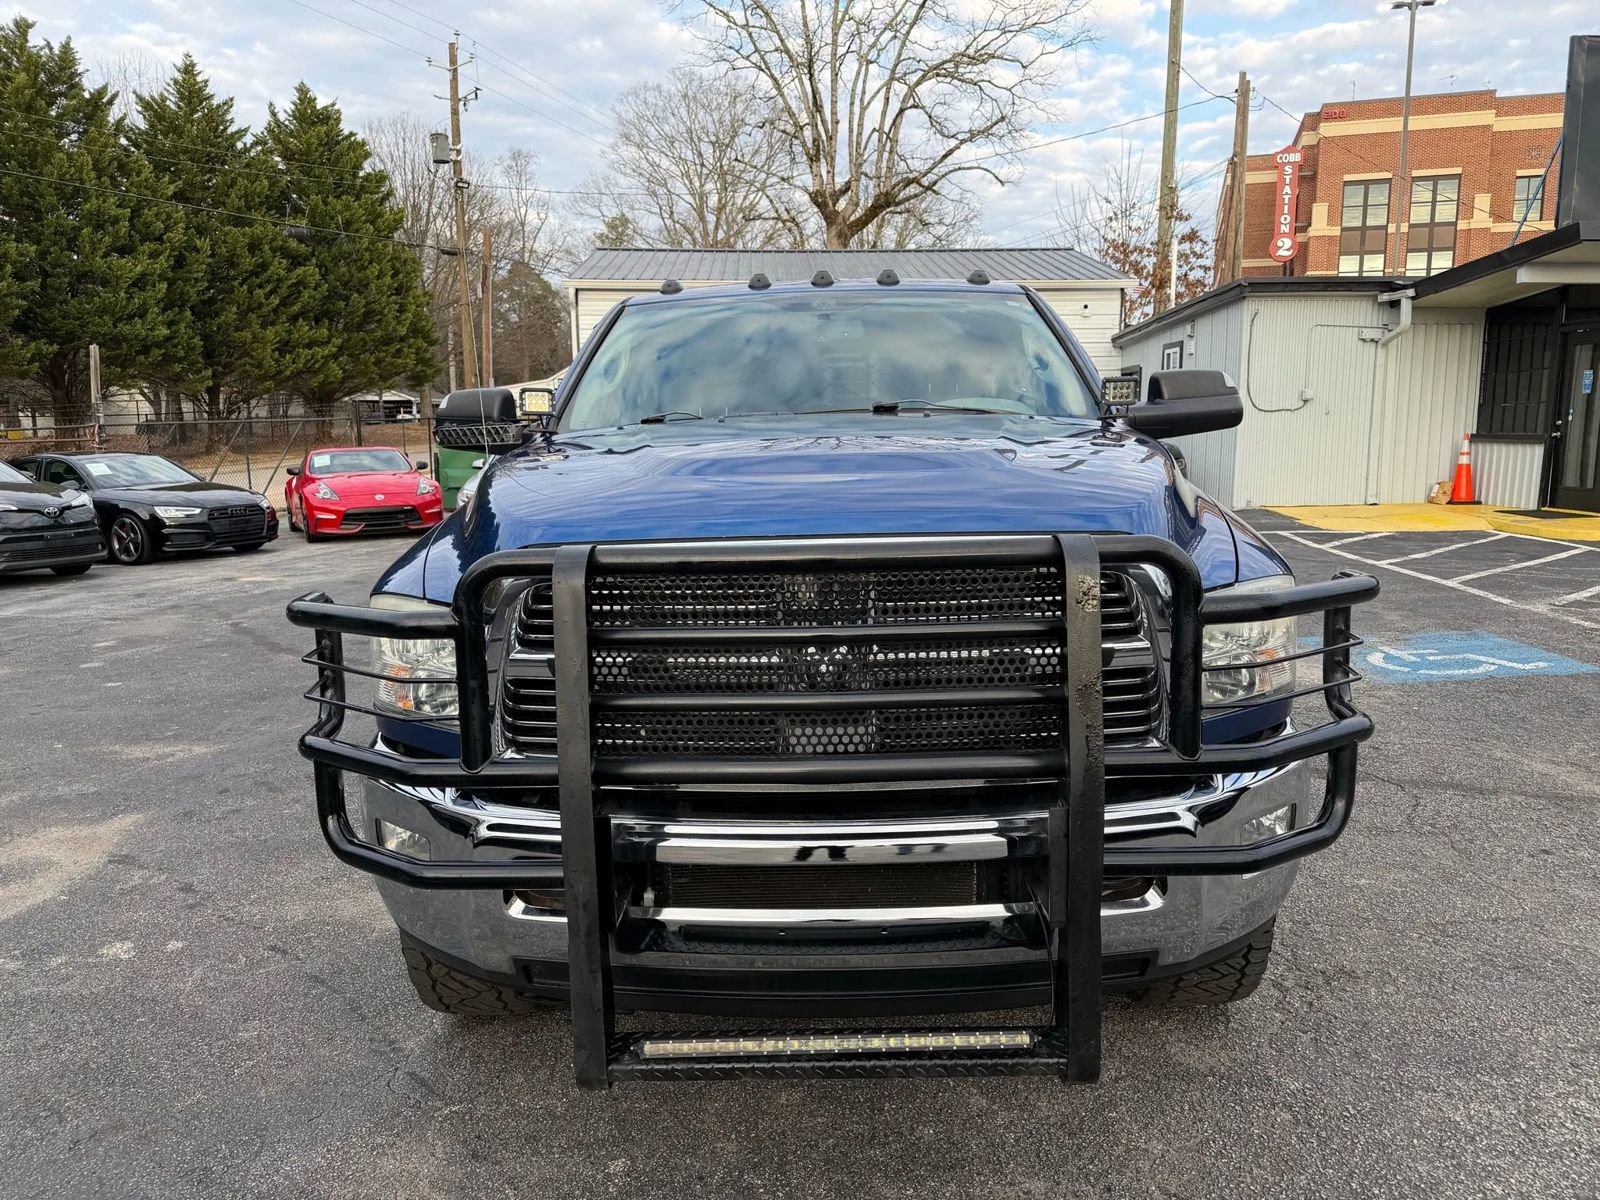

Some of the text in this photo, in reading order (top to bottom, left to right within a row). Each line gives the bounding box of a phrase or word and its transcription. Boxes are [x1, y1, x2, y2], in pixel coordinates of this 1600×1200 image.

[1277, 153, 1301, 163] COBB
[1280, 165, 1293, 233] STATION
[1275, 237, 1294, 257] 2
